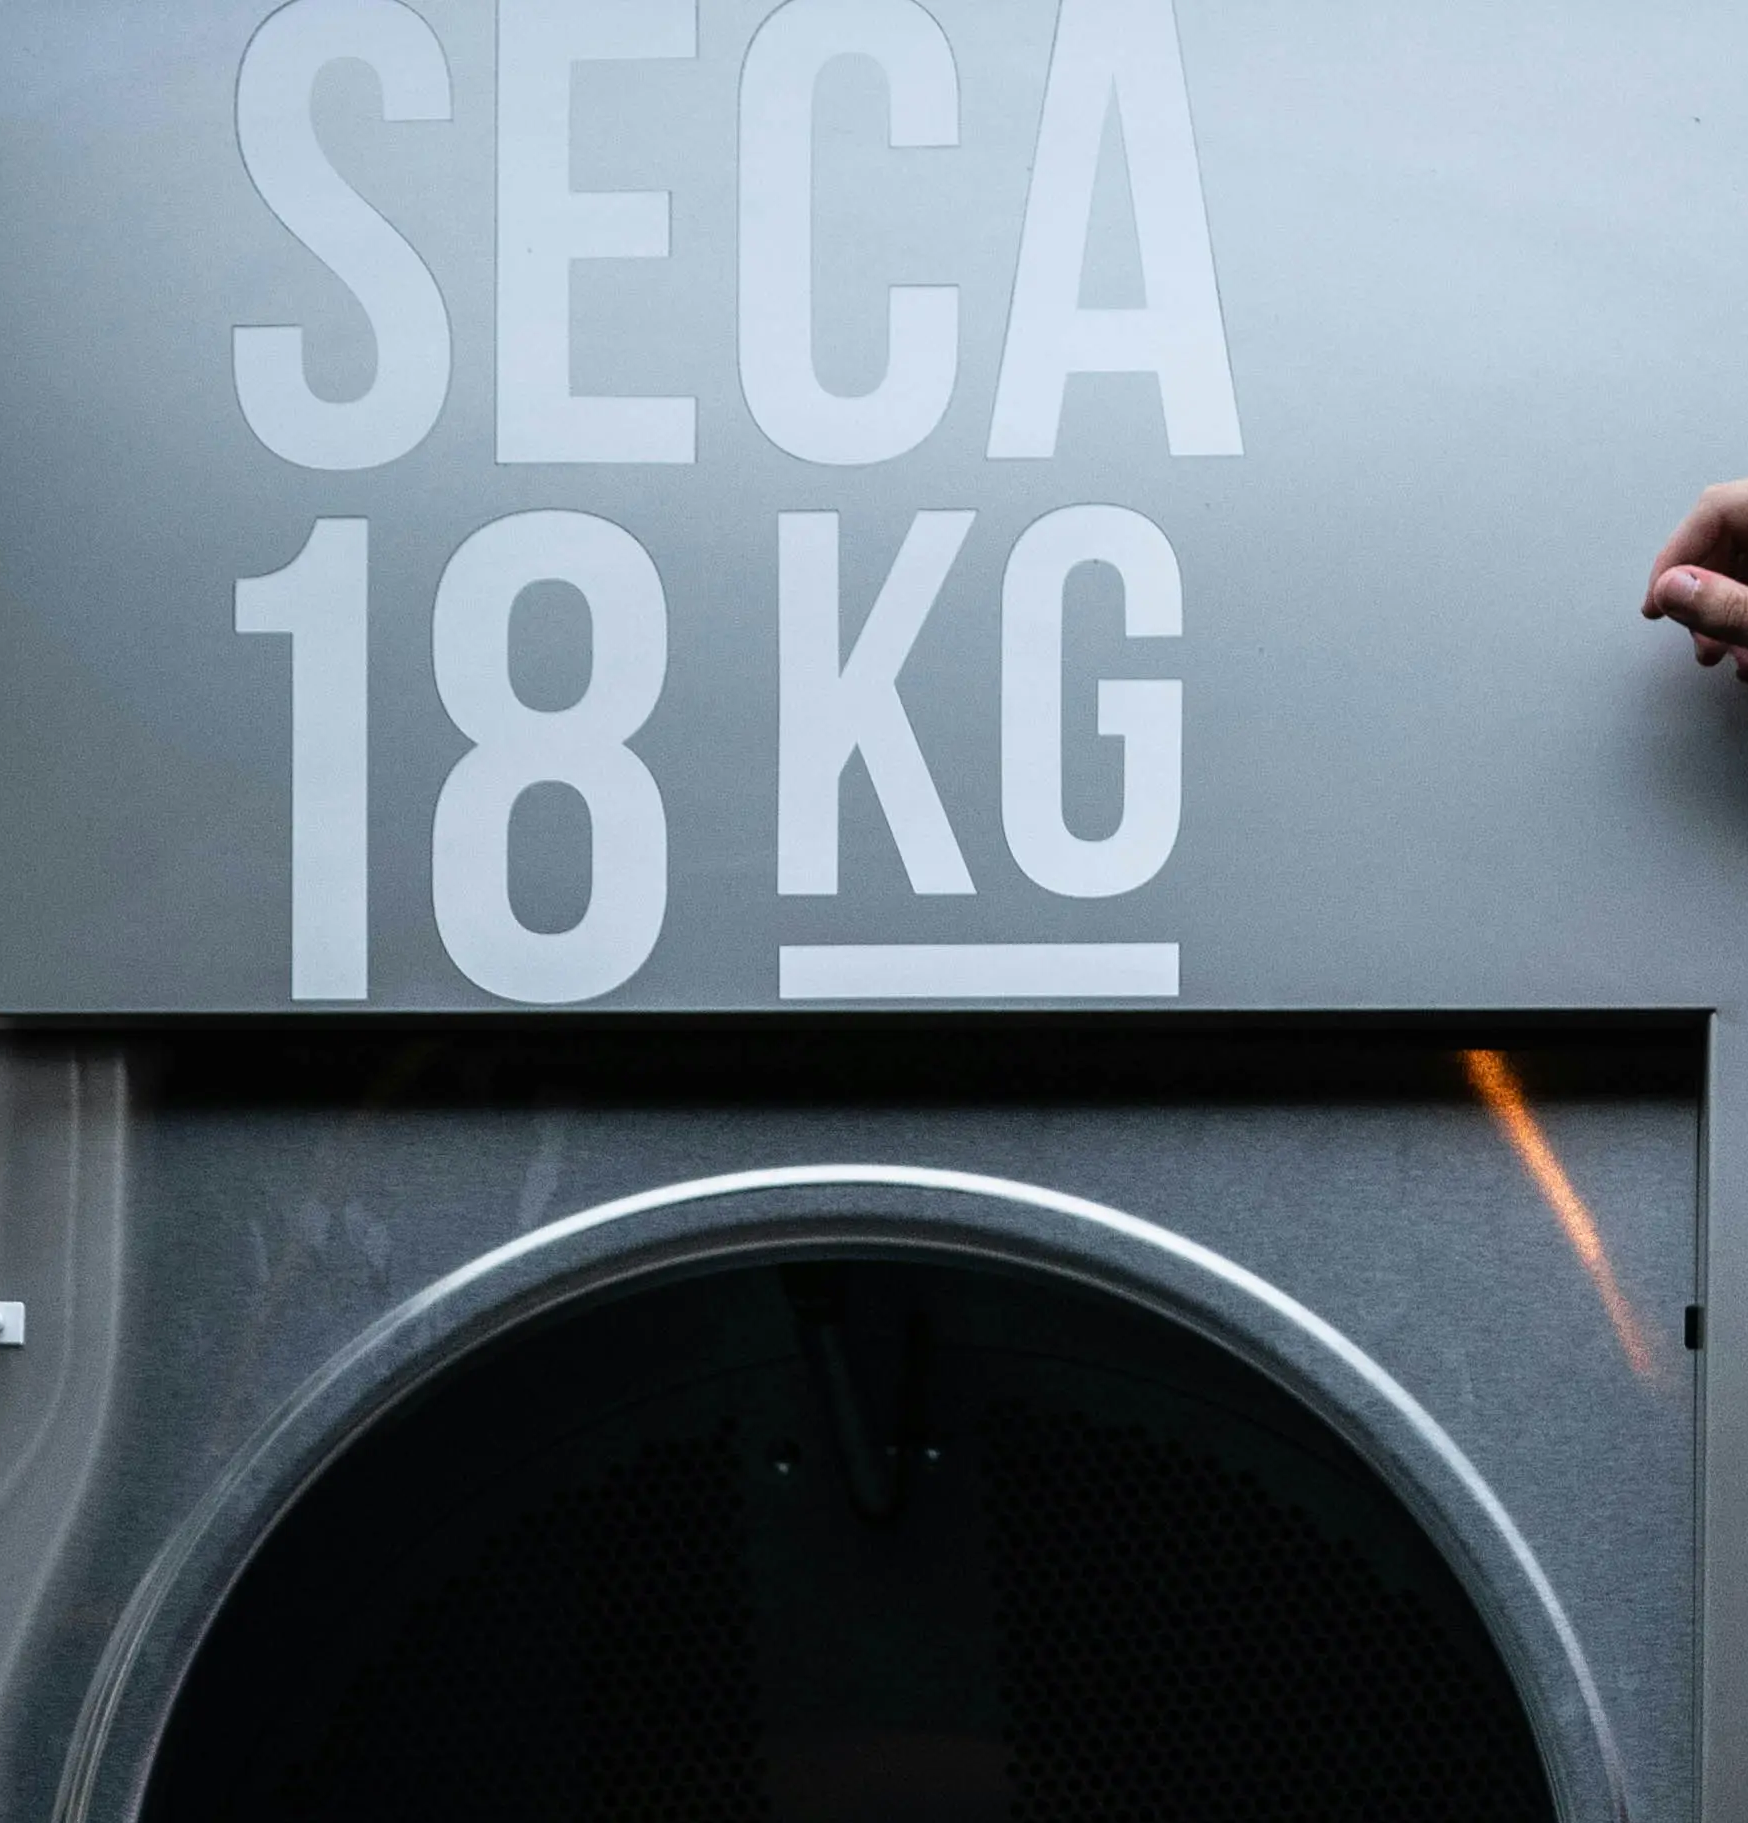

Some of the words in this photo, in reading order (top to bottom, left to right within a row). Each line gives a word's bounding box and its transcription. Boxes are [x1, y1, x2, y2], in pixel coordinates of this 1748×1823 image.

[232, 0, 1244, 470] SECA
[234, 508, 668, 1003] 18
[777, 503, 1183, 898] KG
